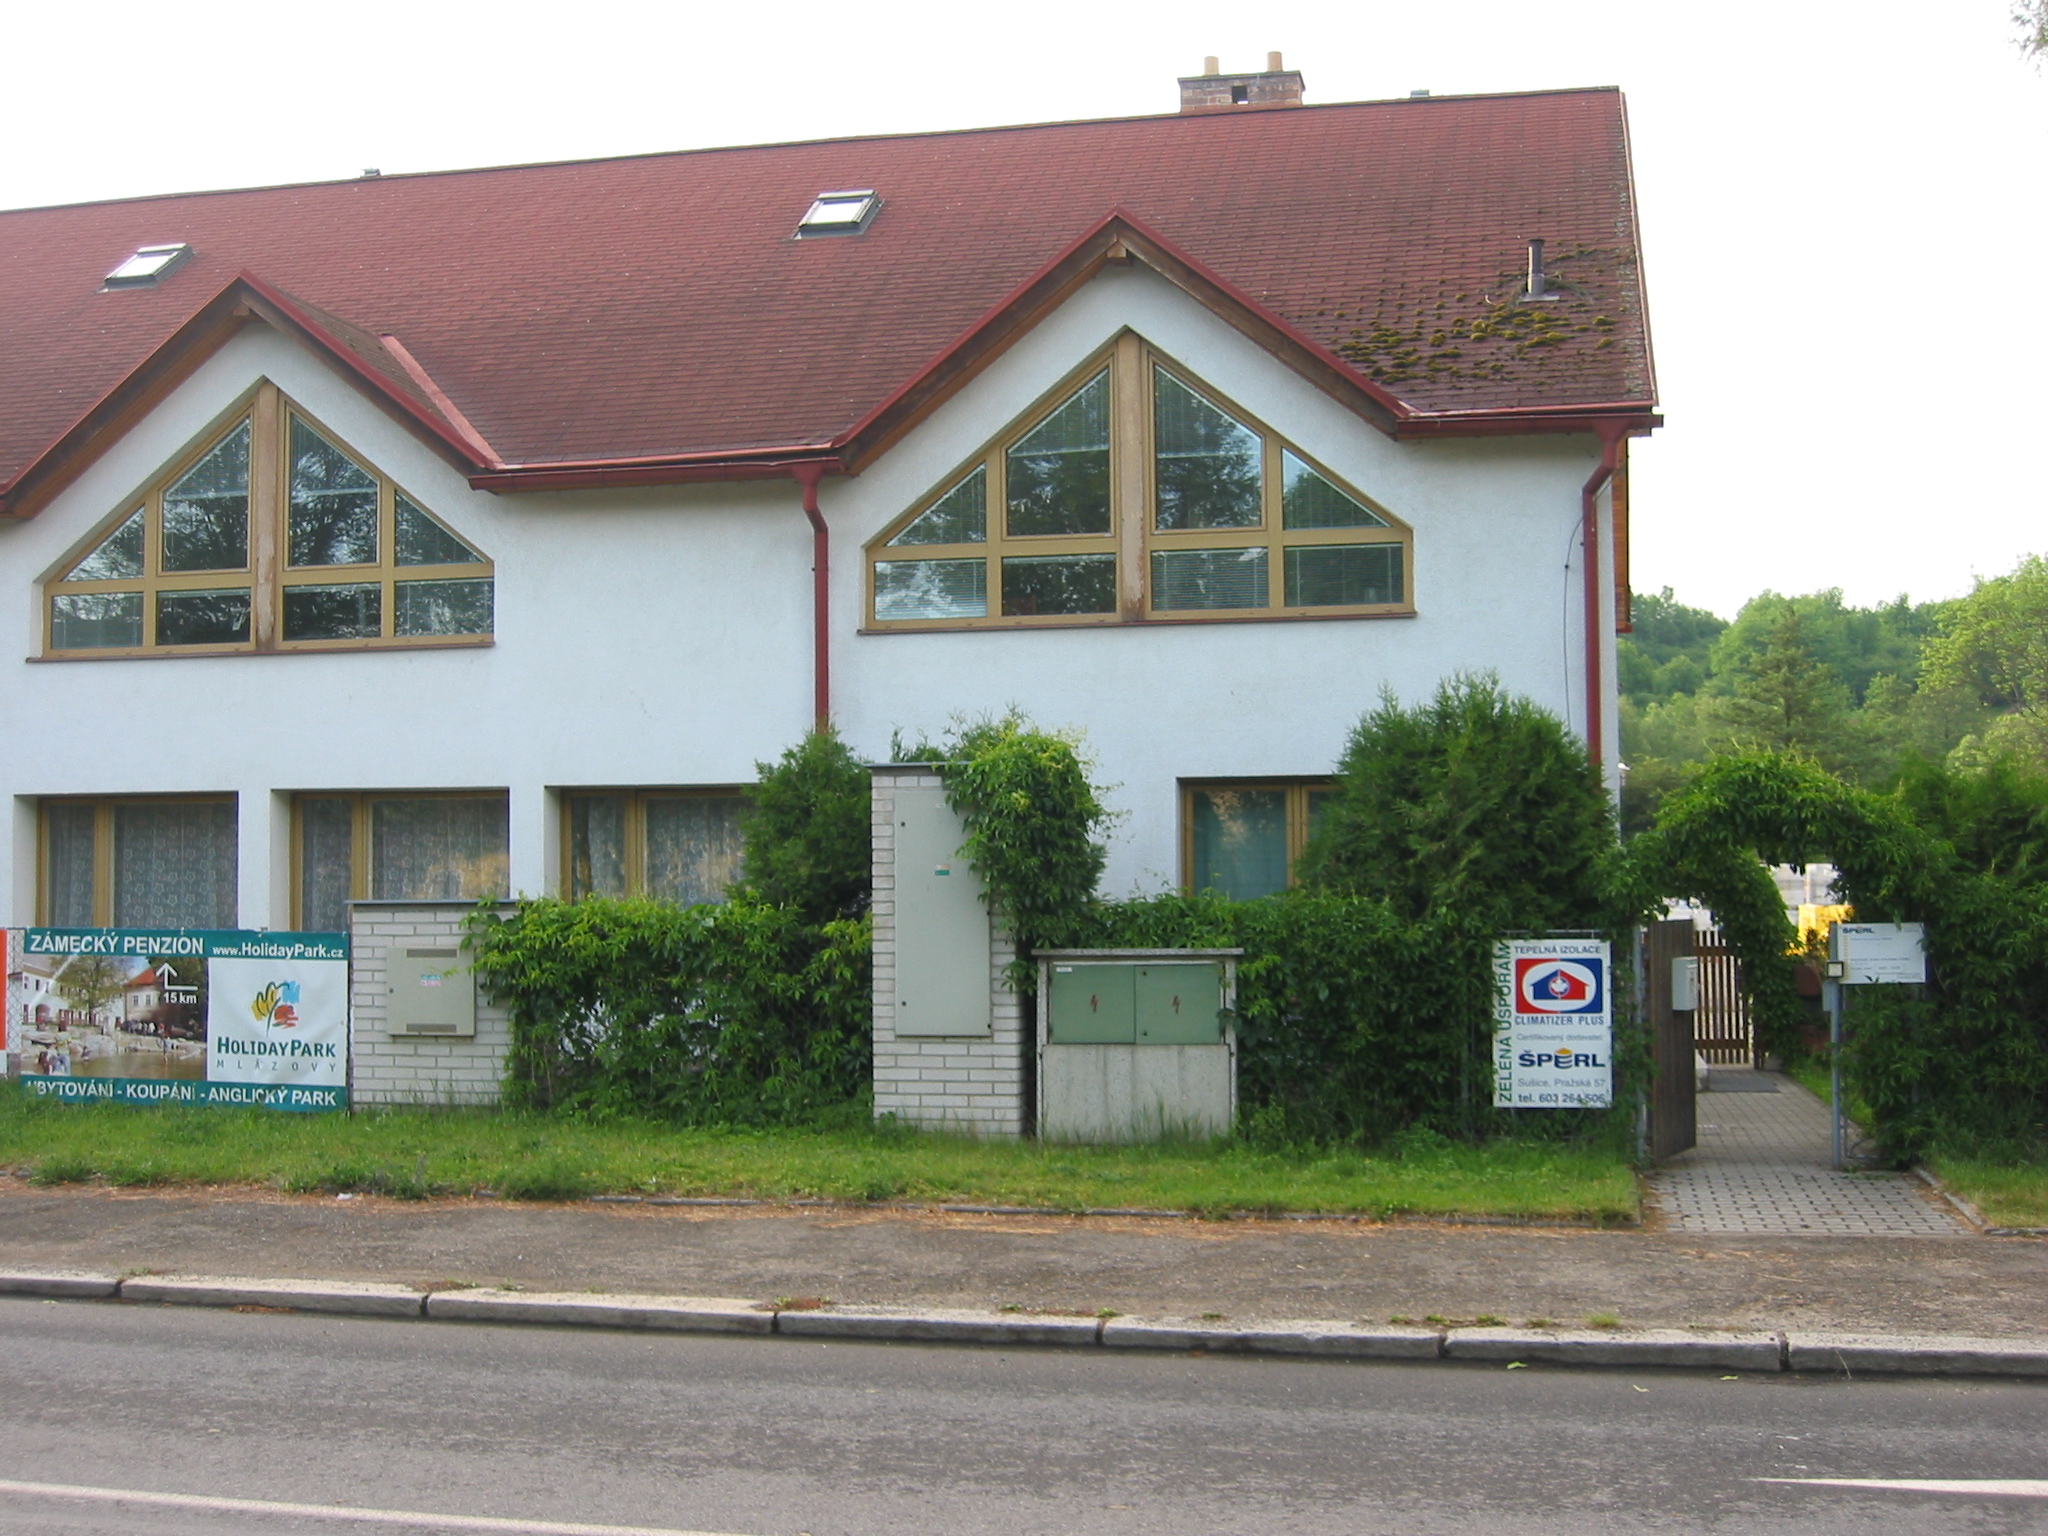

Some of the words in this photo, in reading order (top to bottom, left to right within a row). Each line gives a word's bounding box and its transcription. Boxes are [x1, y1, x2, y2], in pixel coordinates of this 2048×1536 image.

[30, 931, 119, 953] ZÁMECKÝ
[124, 936, 203, 954] PENZION
[1515, 944, 1558, 954] TEPELNÁ
[1560, 945, 1600, 954] IZOLACE
[212, 942, 344, 960] www.HolidayPark.cz
[163, 991, 178, 1004] 15
[179, 992, 197, 1004] km
[1515, 1016, 1573, 1025] CLIMATIZER
[1578, 1015, 1604, 1025] PLUS
[1518, 1048, 1606, 1069] ŠPERL
[126, 1082, 196, 1100] KOUPÁNÍ
[208, 1085, 288, 1104] ANGLICKÝ
[291, 1090, 336, 1106] PARK
[1518, 1093, 1535, 1103] tel.
[1539, 1093, 1559, 1104] 603
